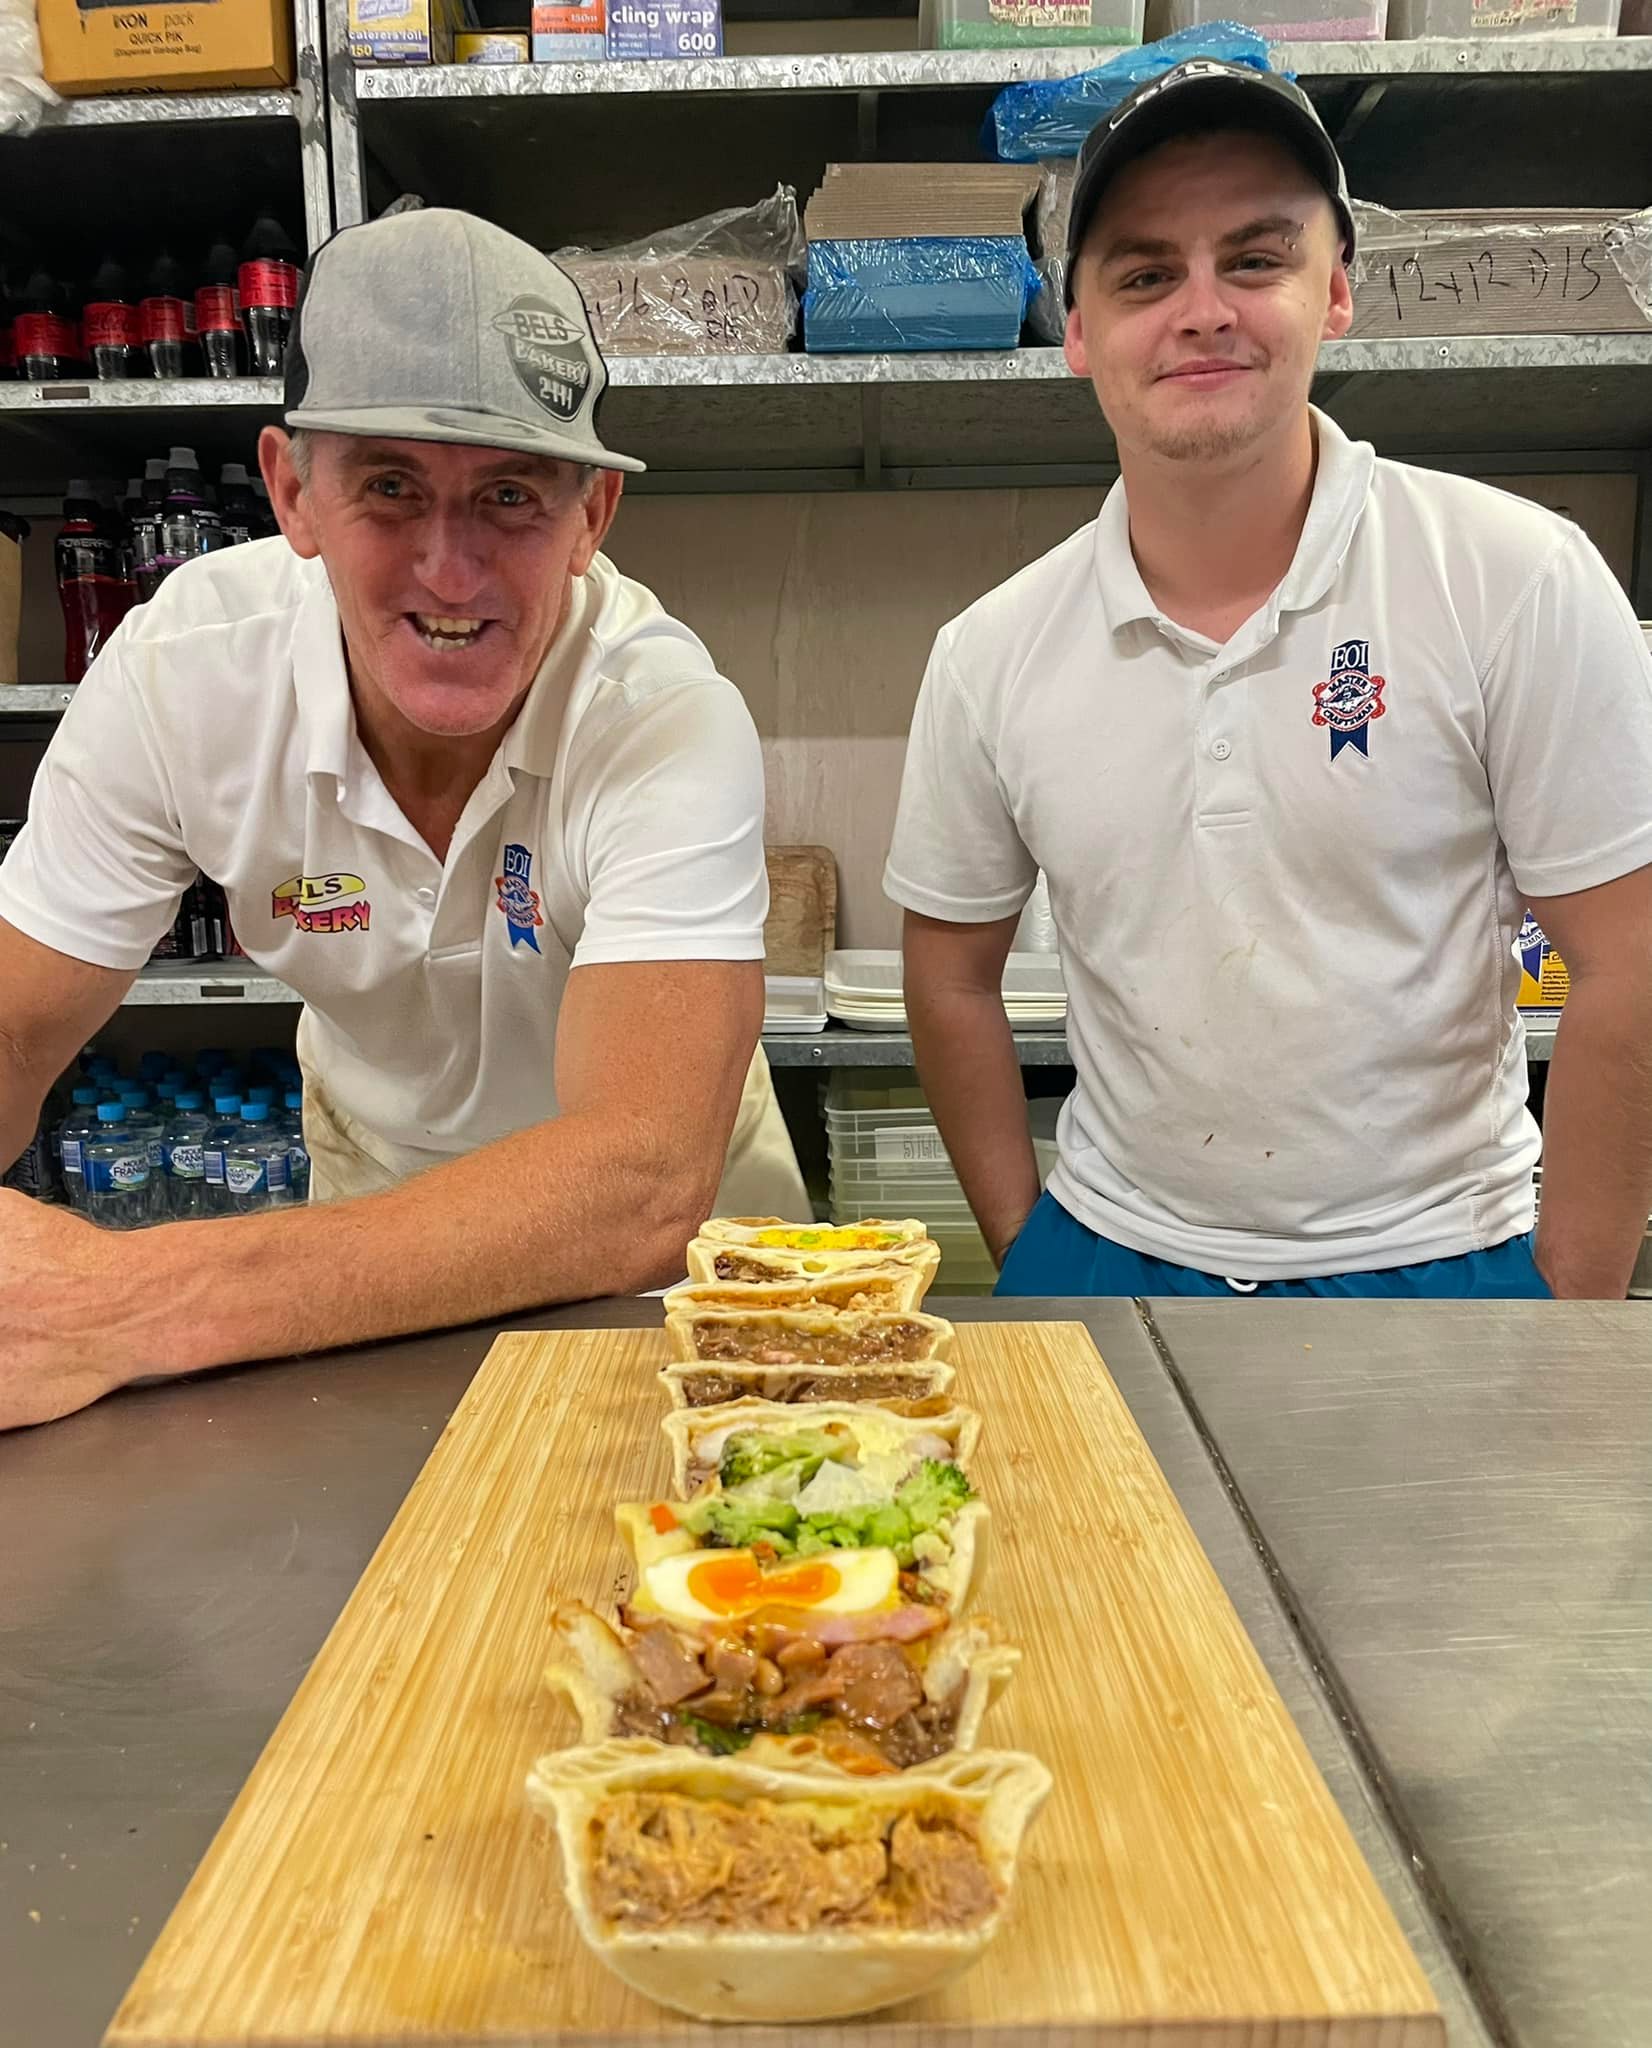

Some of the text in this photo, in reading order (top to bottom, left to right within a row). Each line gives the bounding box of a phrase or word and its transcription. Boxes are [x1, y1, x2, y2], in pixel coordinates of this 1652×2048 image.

[112, 12, 148, 30] IKON
[611, 5, 715, 28] cling wrap
[129, 32, 164, 46] QUICK
[402, 28, 423, 40] foil
[678, 32, 717, 51] 600
[351, 44, 373, 57] 150
[512, 312, 569, 341] BELS
[514, 338, 588, 388] BAKERY
[1332, 642, 1368, 671] EOI
[1329, 675, 1368, 692] MASTER
[505, 848, 530, 878] EOI
[272, 900, 371, 933] BKERY
